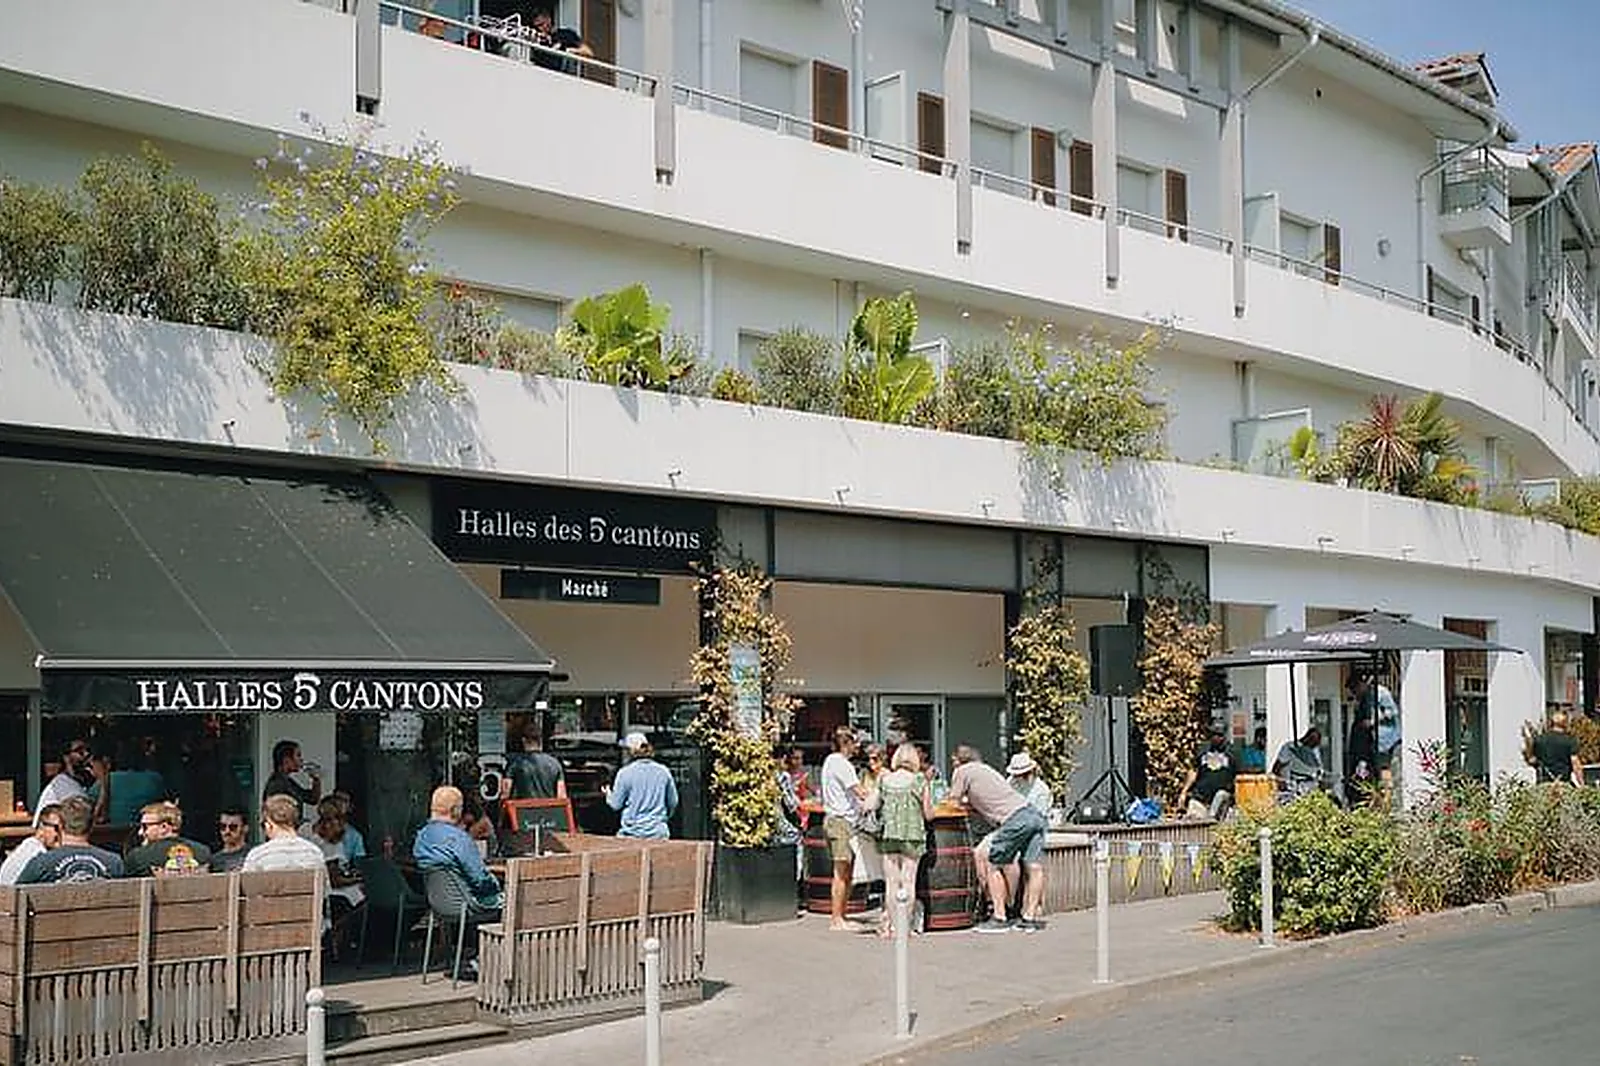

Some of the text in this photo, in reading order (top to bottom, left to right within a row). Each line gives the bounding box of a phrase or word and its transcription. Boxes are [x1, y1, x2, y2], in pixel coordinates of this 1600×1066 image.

[457, 508, 701, 550] Halles des 5 cantons
[561, 578, 609, 598] Marché
[136, 672, 484, 711] HALLES 5 CANTONS
